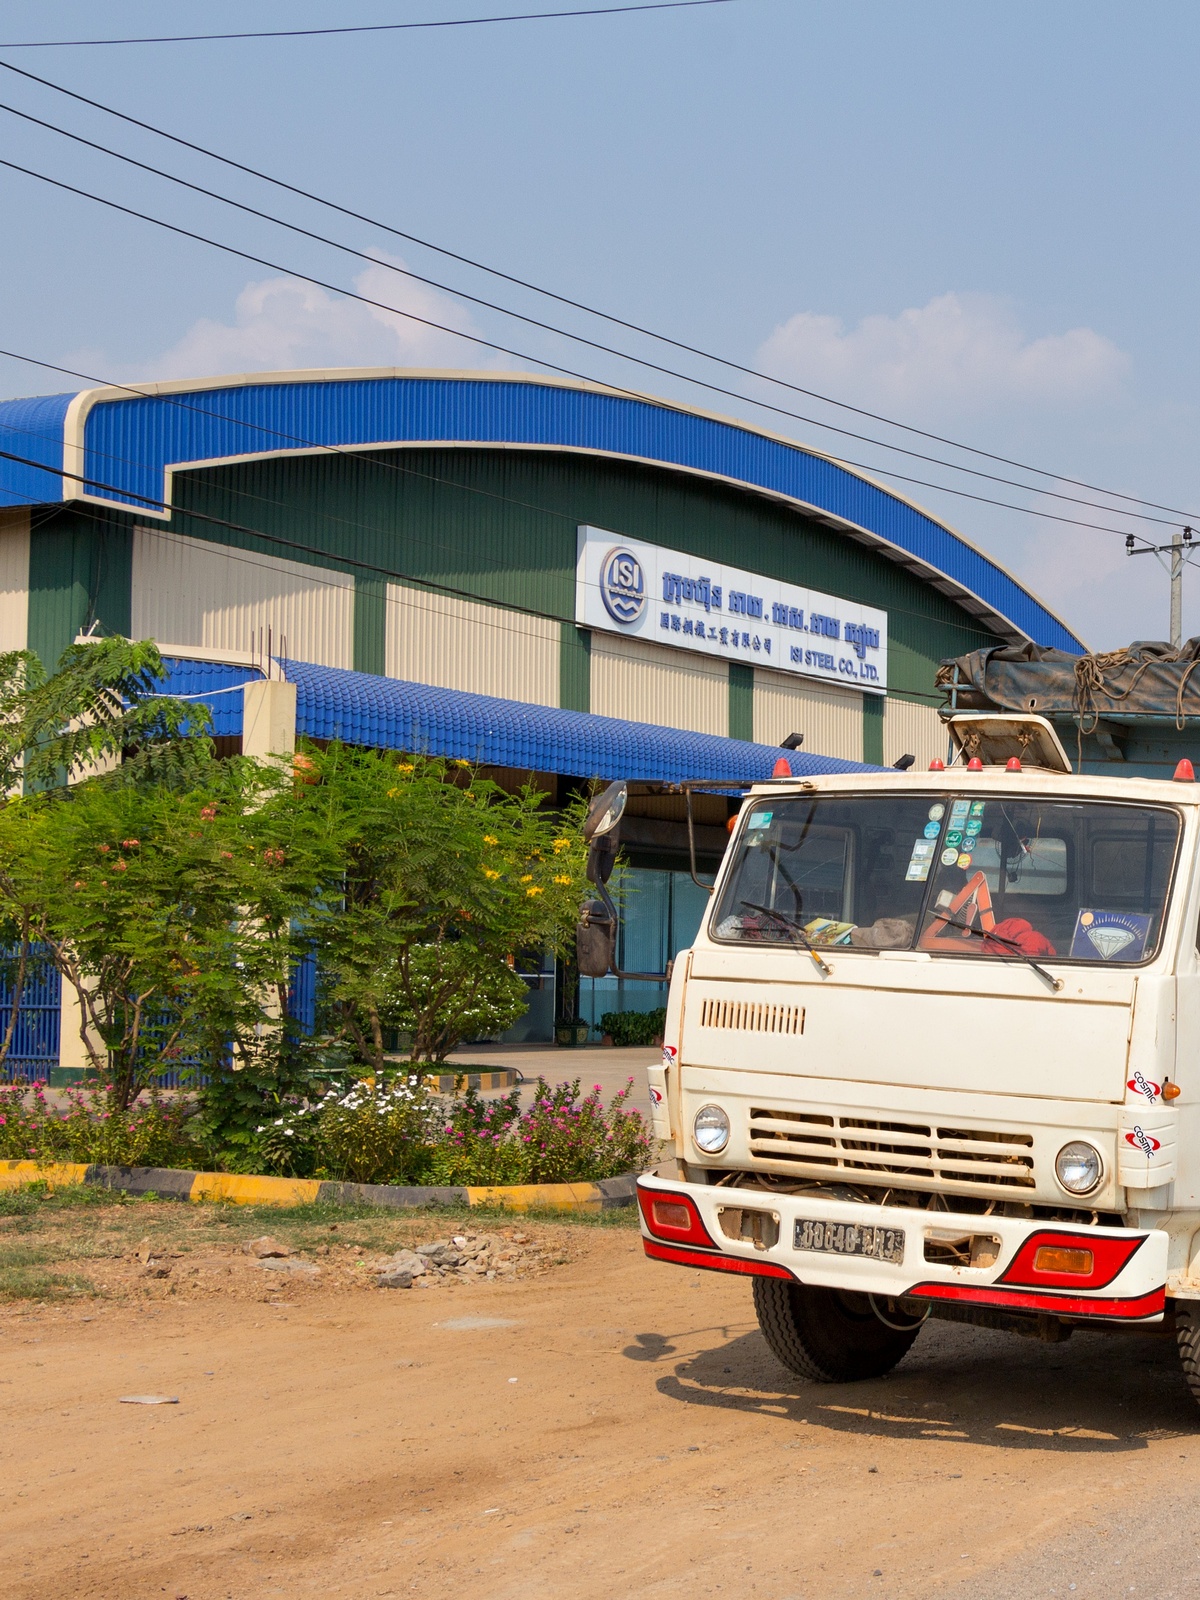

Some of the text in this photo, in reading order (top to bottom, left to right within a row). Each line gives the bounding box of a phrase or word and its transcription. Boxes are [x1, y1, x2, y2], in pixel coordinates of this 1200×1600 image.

[613, 559, 639, 590] ISI
[662, 572, 722, 612] ក្រុមហ៊ុន
[790, 645, 879, 681] ISI STEEL CO., LTD.
